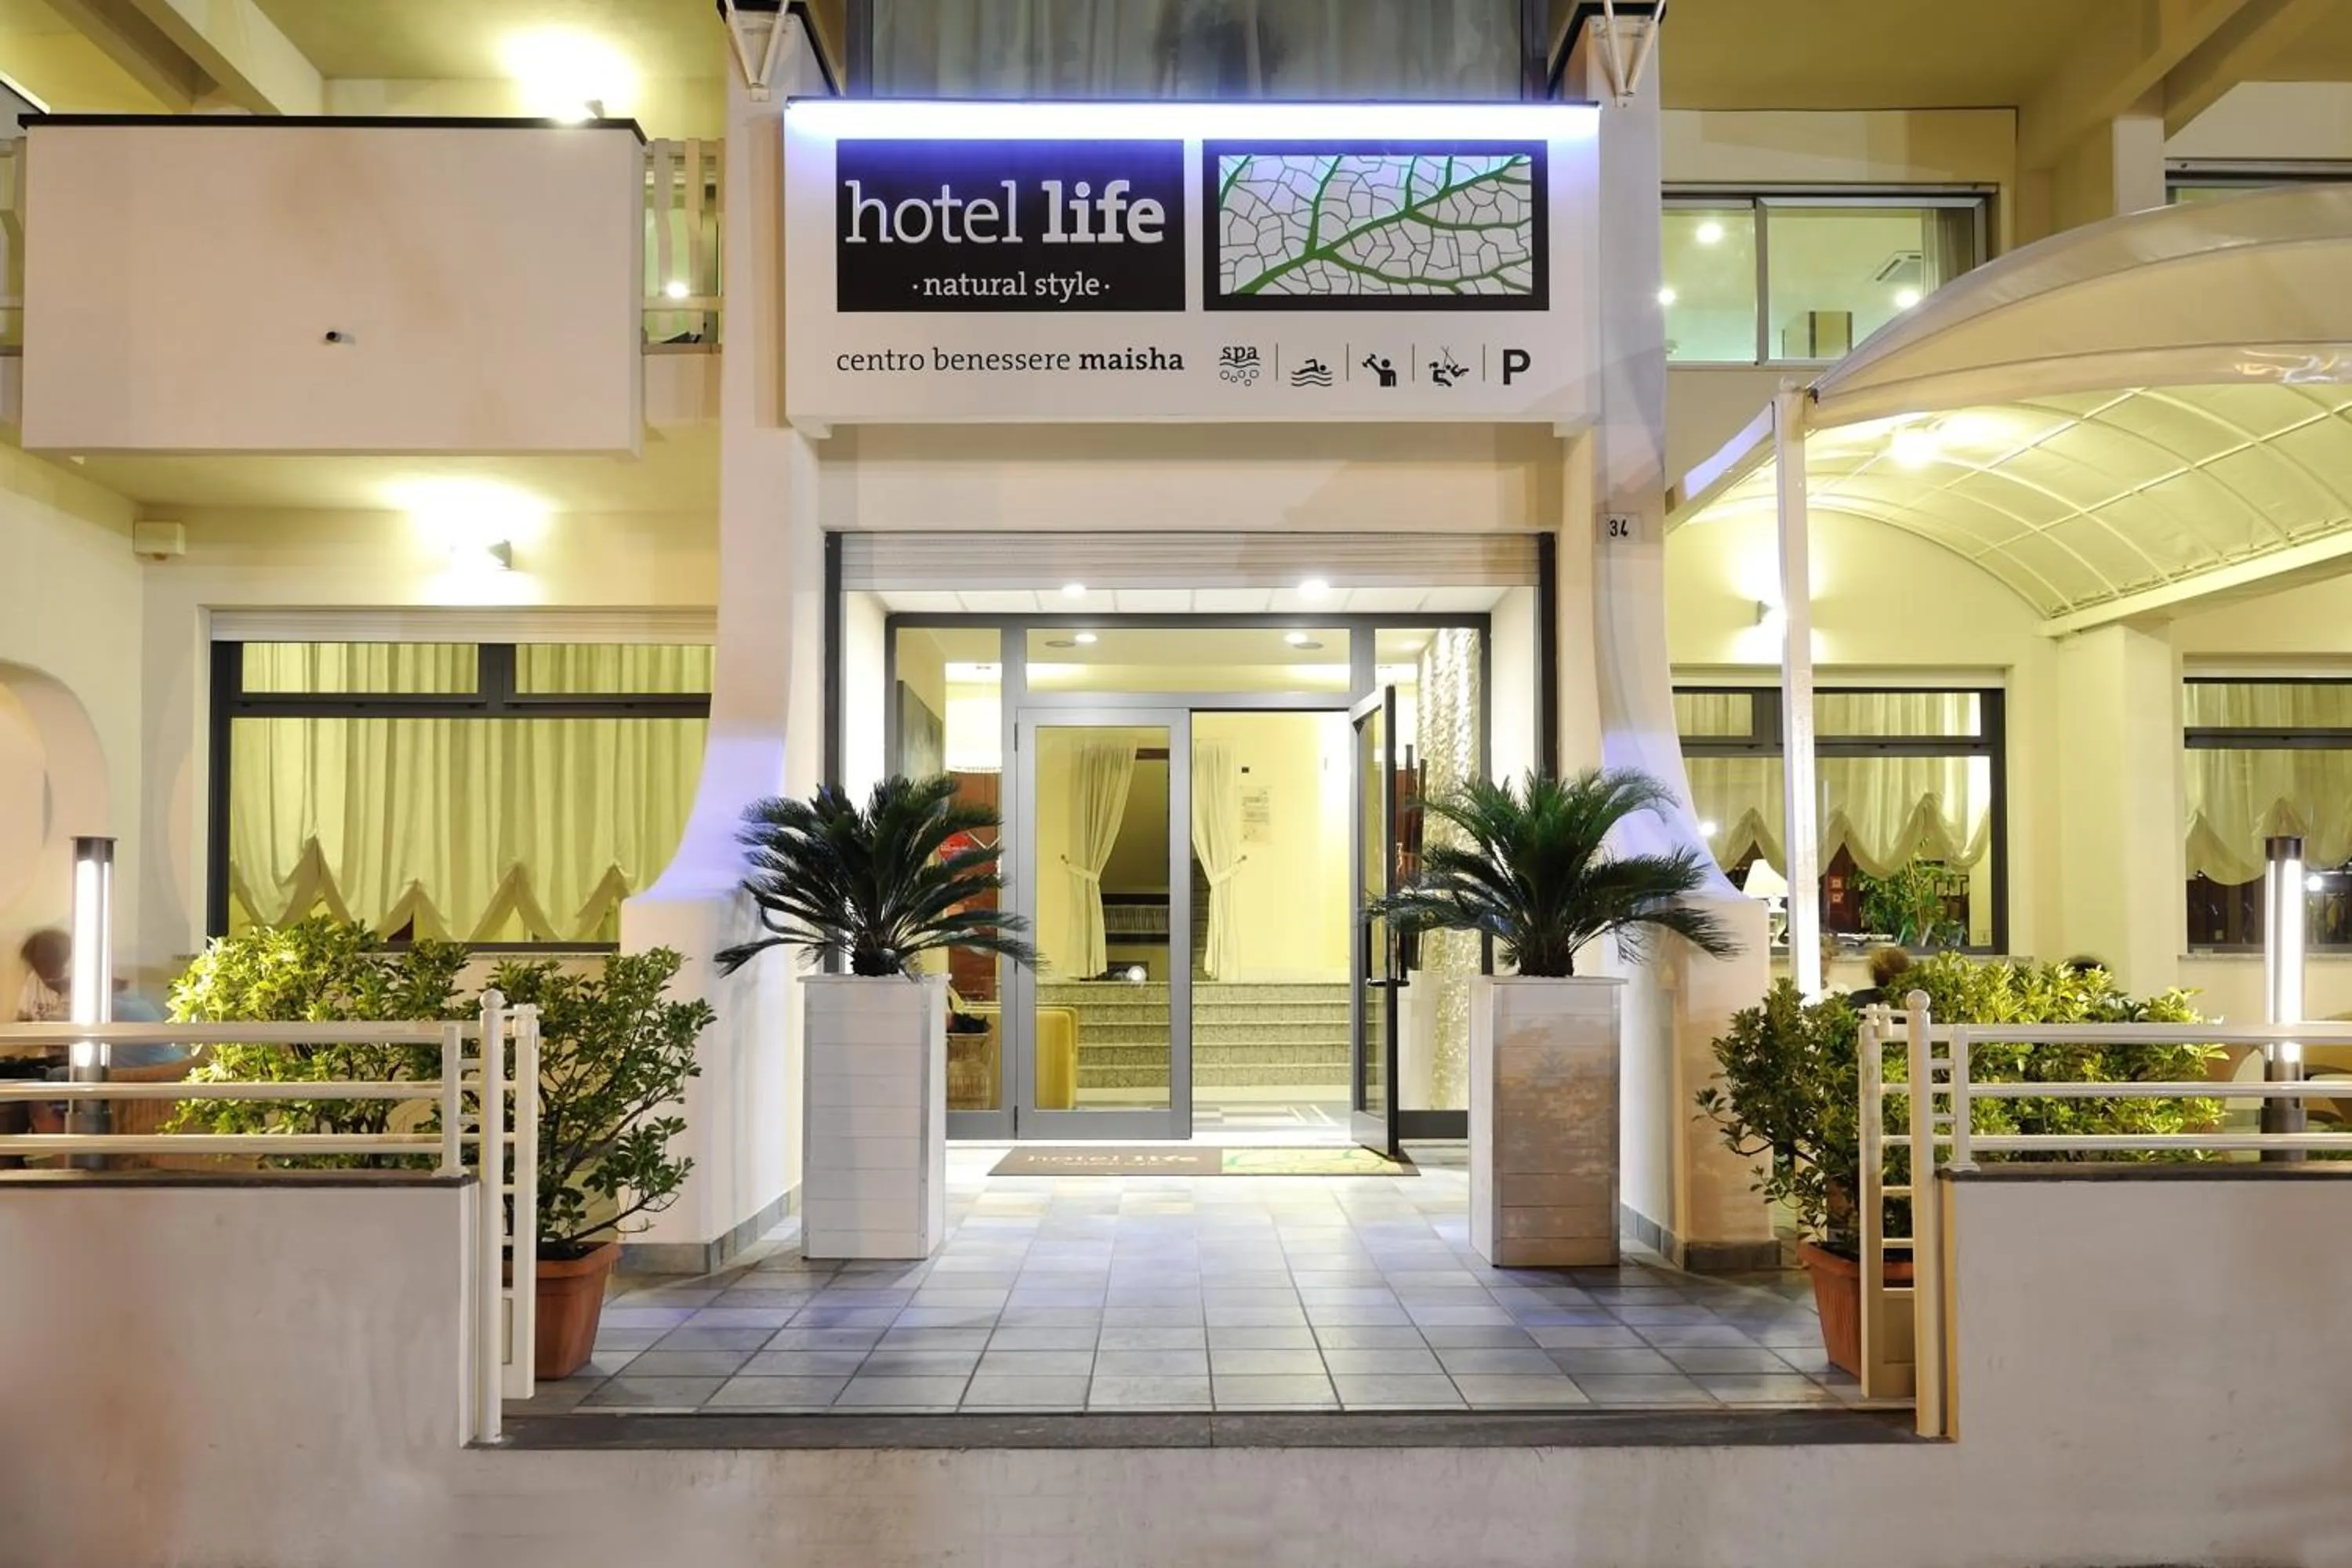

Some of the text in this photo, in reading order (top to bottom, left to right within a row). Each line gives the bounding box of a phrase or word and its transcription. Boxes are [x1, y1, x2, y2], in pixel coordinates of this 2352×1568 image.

[844, 180, 1166, 244] hotel life
[837, 346, 1185, 371] centro benessere maisha
[1221, 346, 1258, 365] spa
[1503, 349, 1531, 385] P
[1609, 518, 1628, 537] 34
